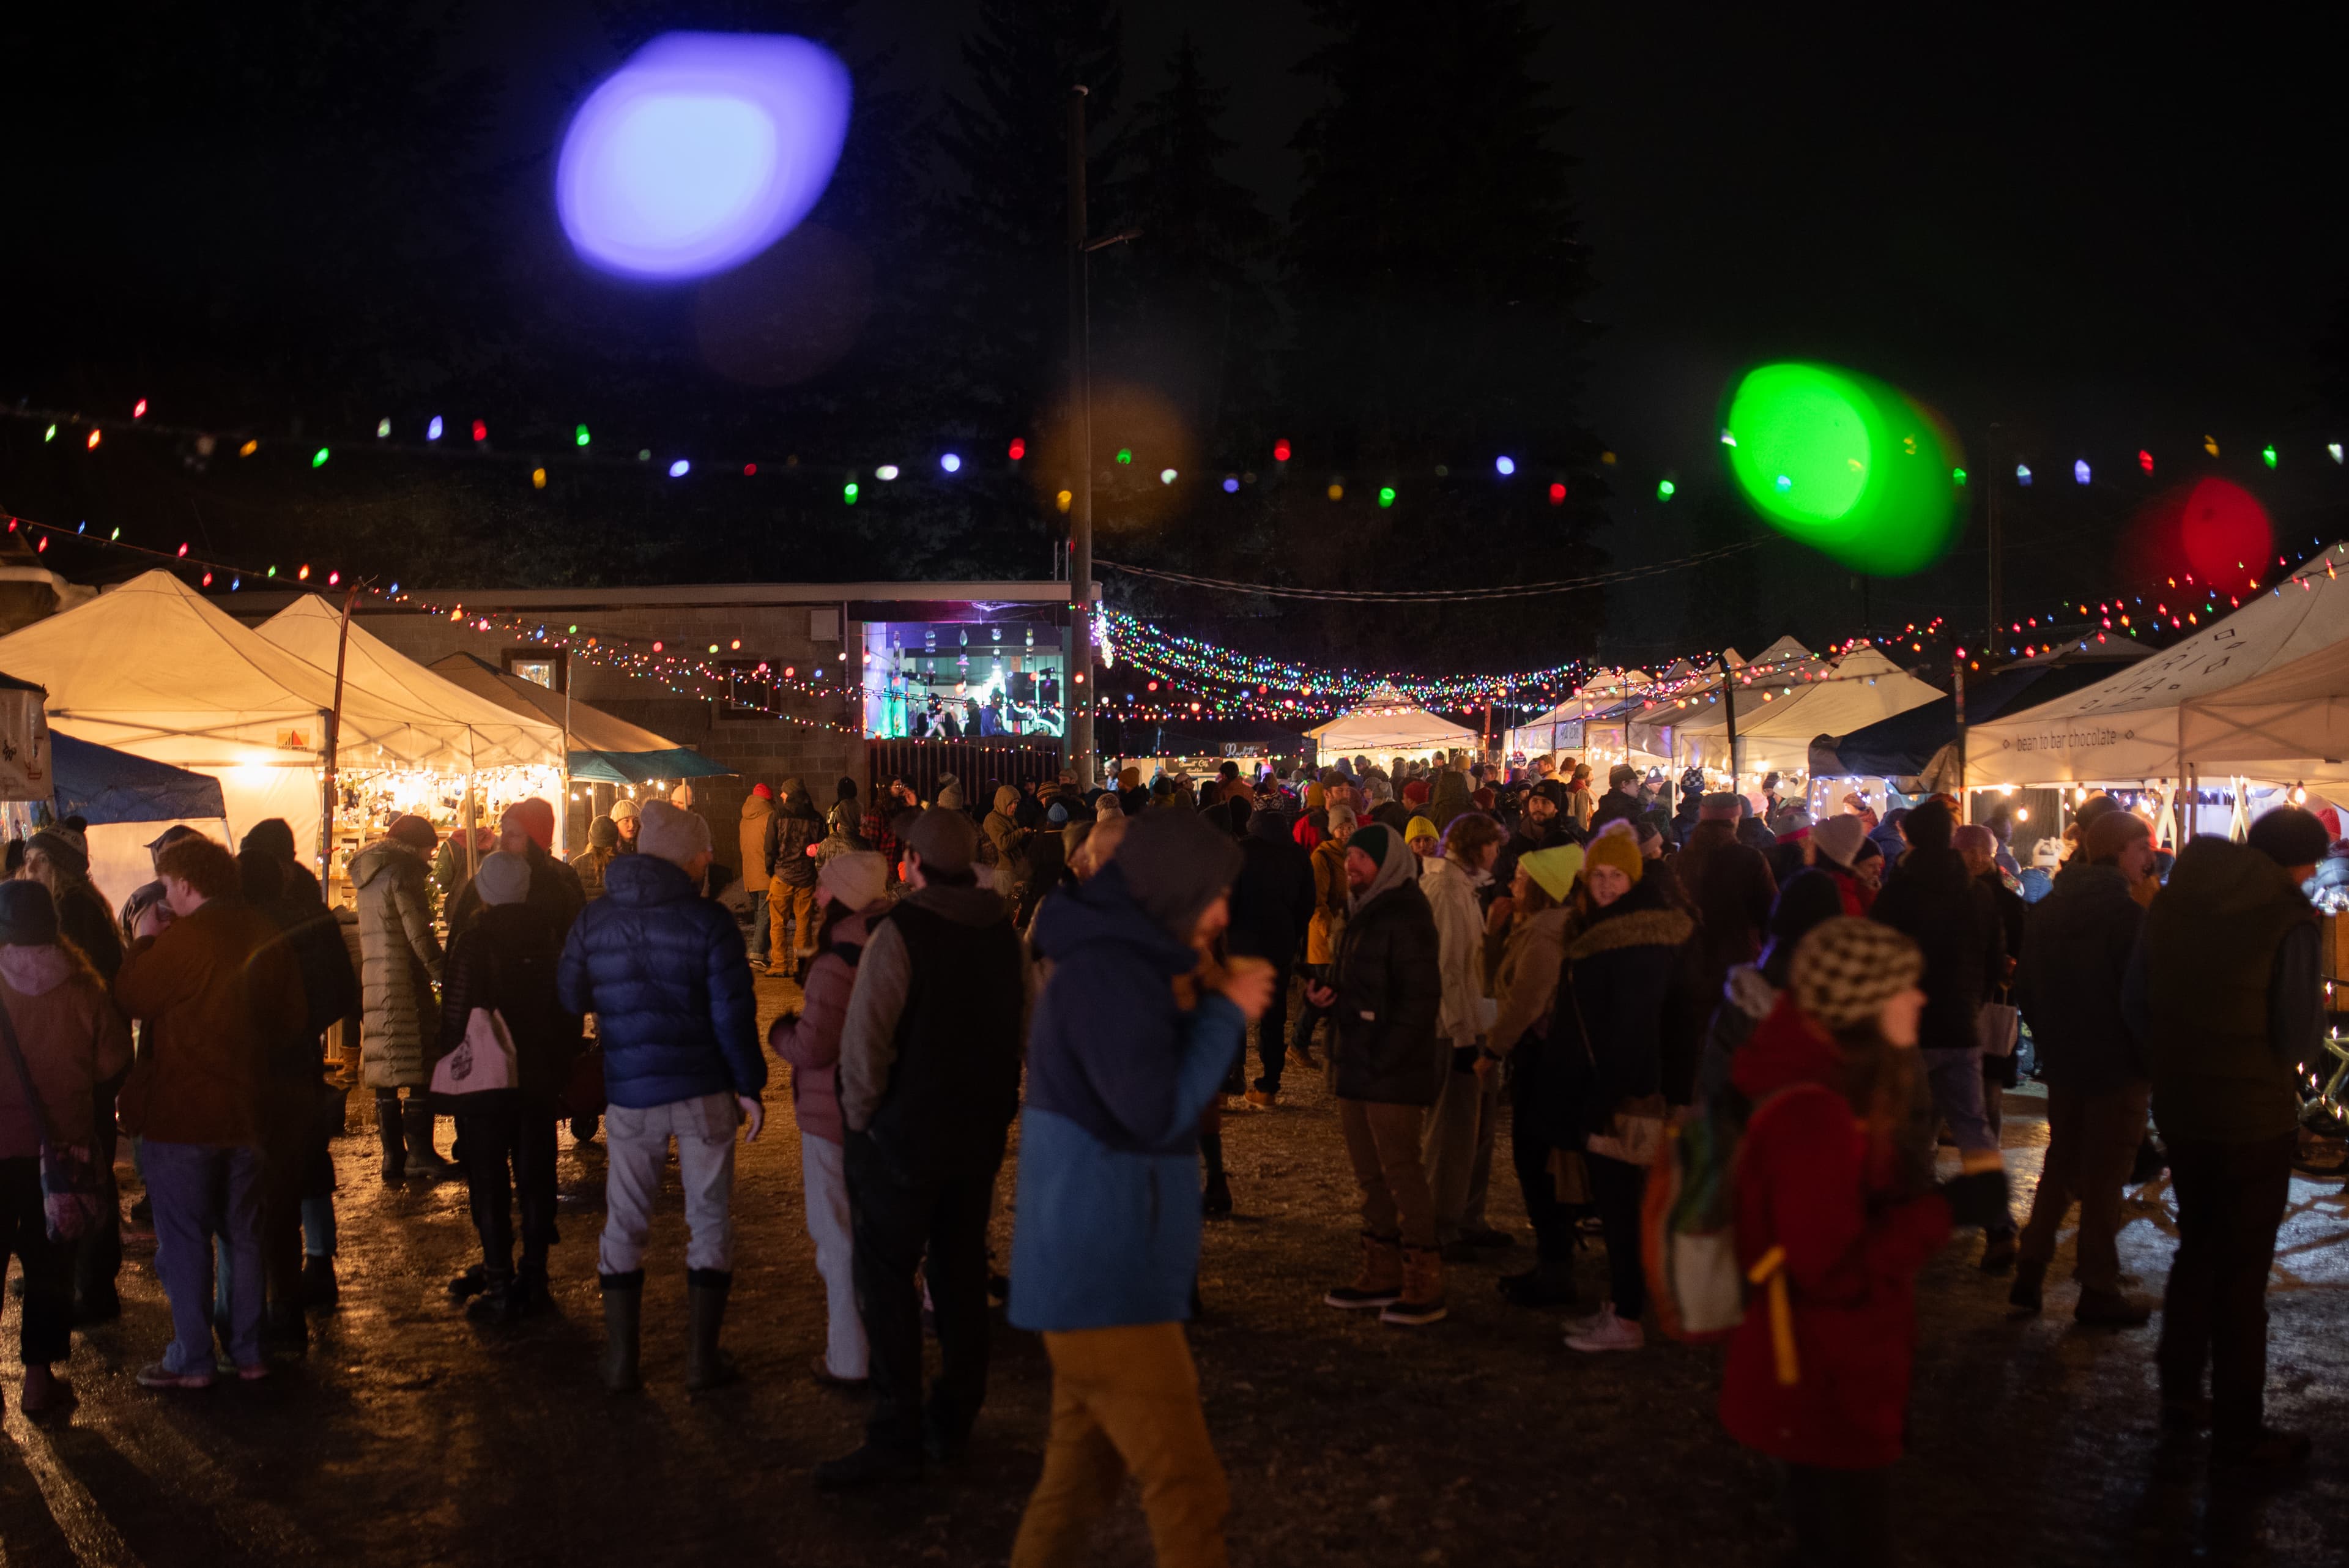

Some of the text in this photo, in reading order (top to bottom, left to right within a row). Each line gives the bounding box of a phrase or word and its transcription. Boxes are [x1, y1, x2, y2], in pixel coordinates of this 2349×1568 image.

[2017, 728, 2116, 751] bean to bar chocolate
